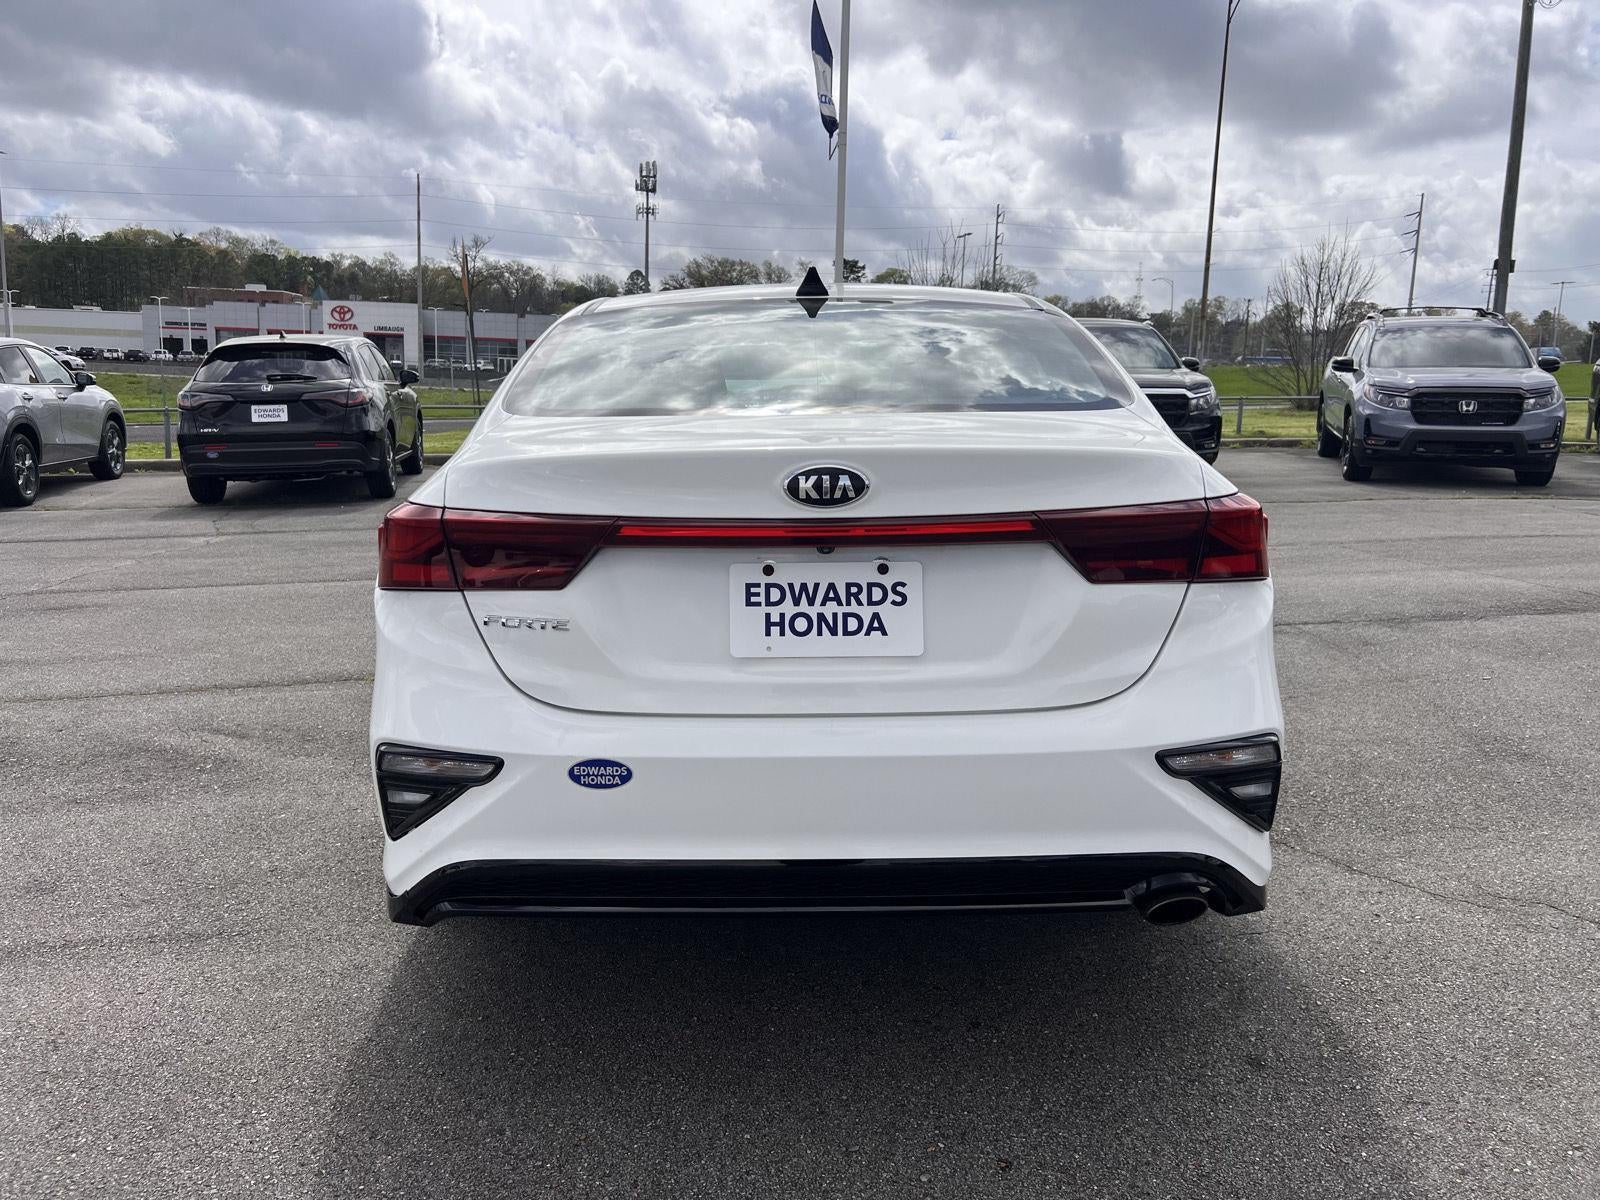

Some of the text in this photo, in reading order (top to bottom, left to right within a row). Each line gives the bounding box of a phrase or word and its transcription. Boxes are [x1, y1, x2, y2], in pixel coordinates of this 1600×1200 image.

[327, 323, 358, 331] TOYOTA
[797, 474, 856, 499] KIA
[744, 581, 908, 607] EDWARDS
[483, 614, 570, 631] FORTE
[764, 612, 888, 637] HONDA
[573, 766, 628, 775] EDWARDS
[580, 775, 621, 785] HONDA
